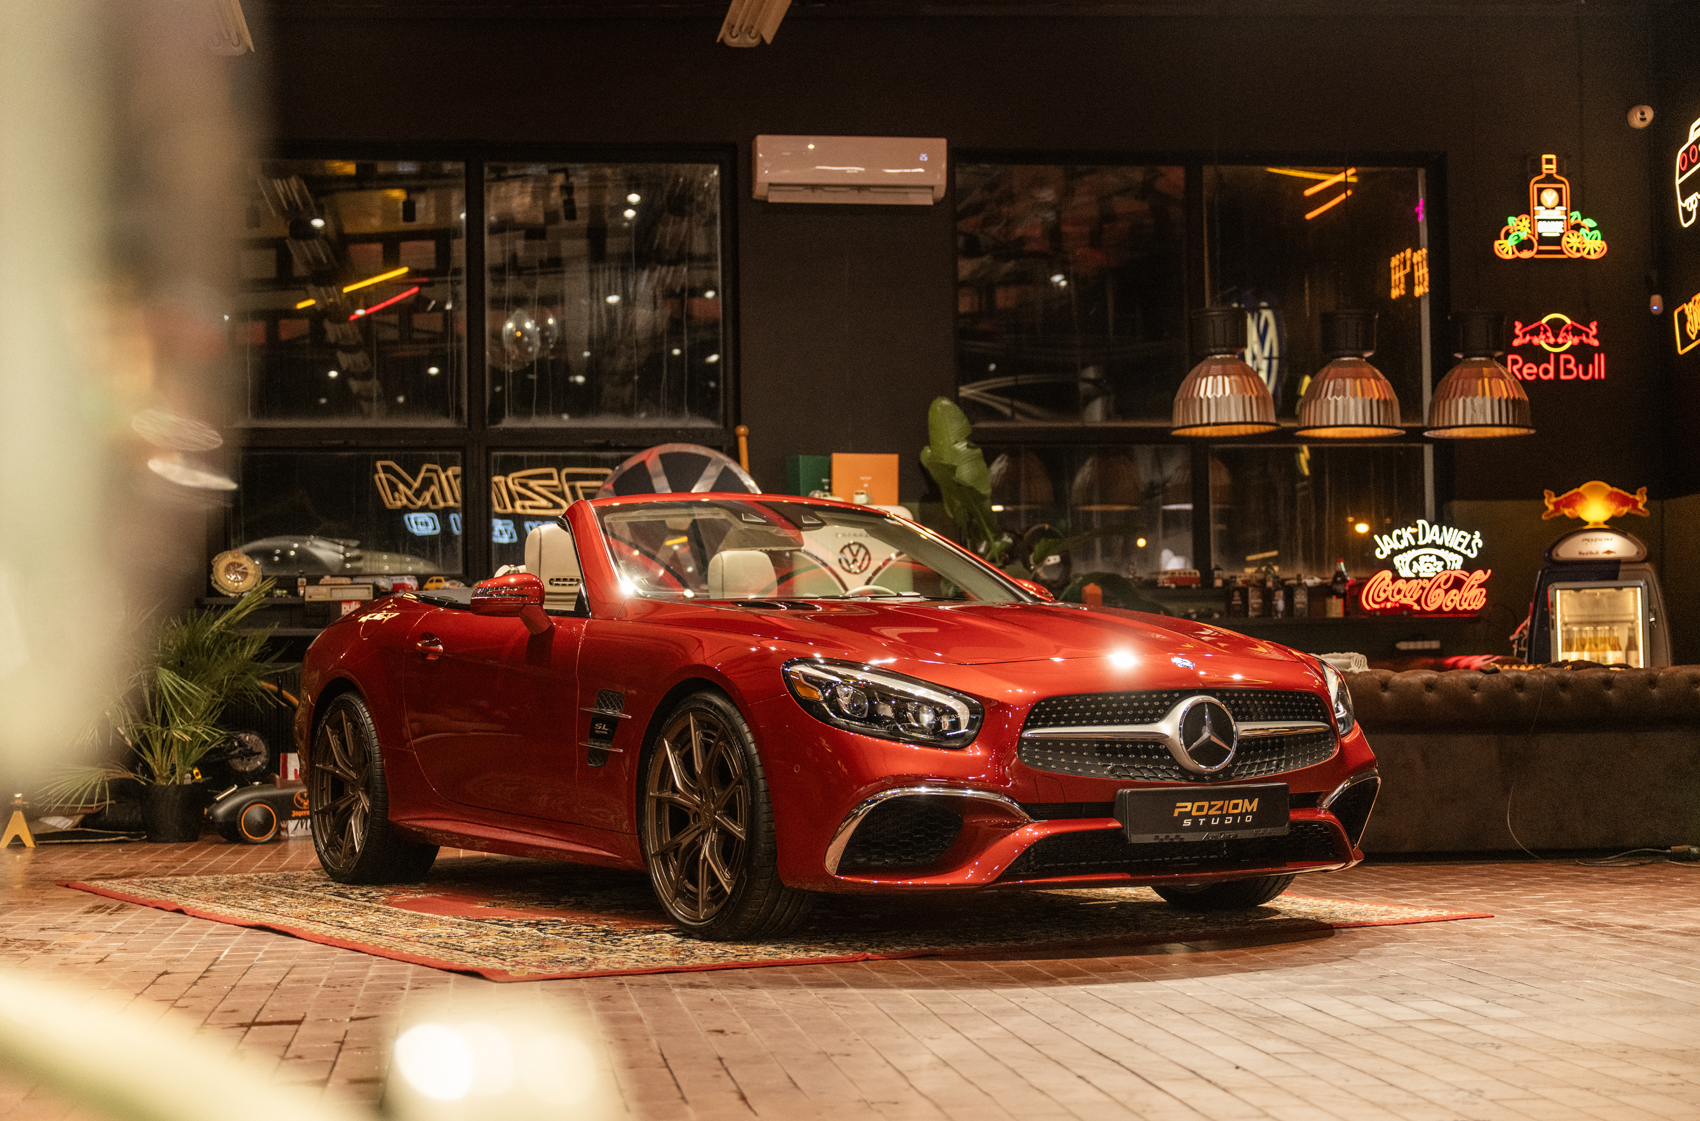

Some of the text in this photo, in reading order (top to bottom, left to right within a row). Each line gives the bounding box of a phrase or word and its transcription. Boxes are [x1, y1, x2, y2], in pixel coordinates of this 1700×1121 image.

[1507, 353, 1605, 381] Red Bull
[1374, 519, 1483, 559] JACK DANIEL'S
[594, 723, 609, 731] SL
[1173, 798, 1259, 817] POZIOM
[1183, 815, 1253, 827] STUDIO
